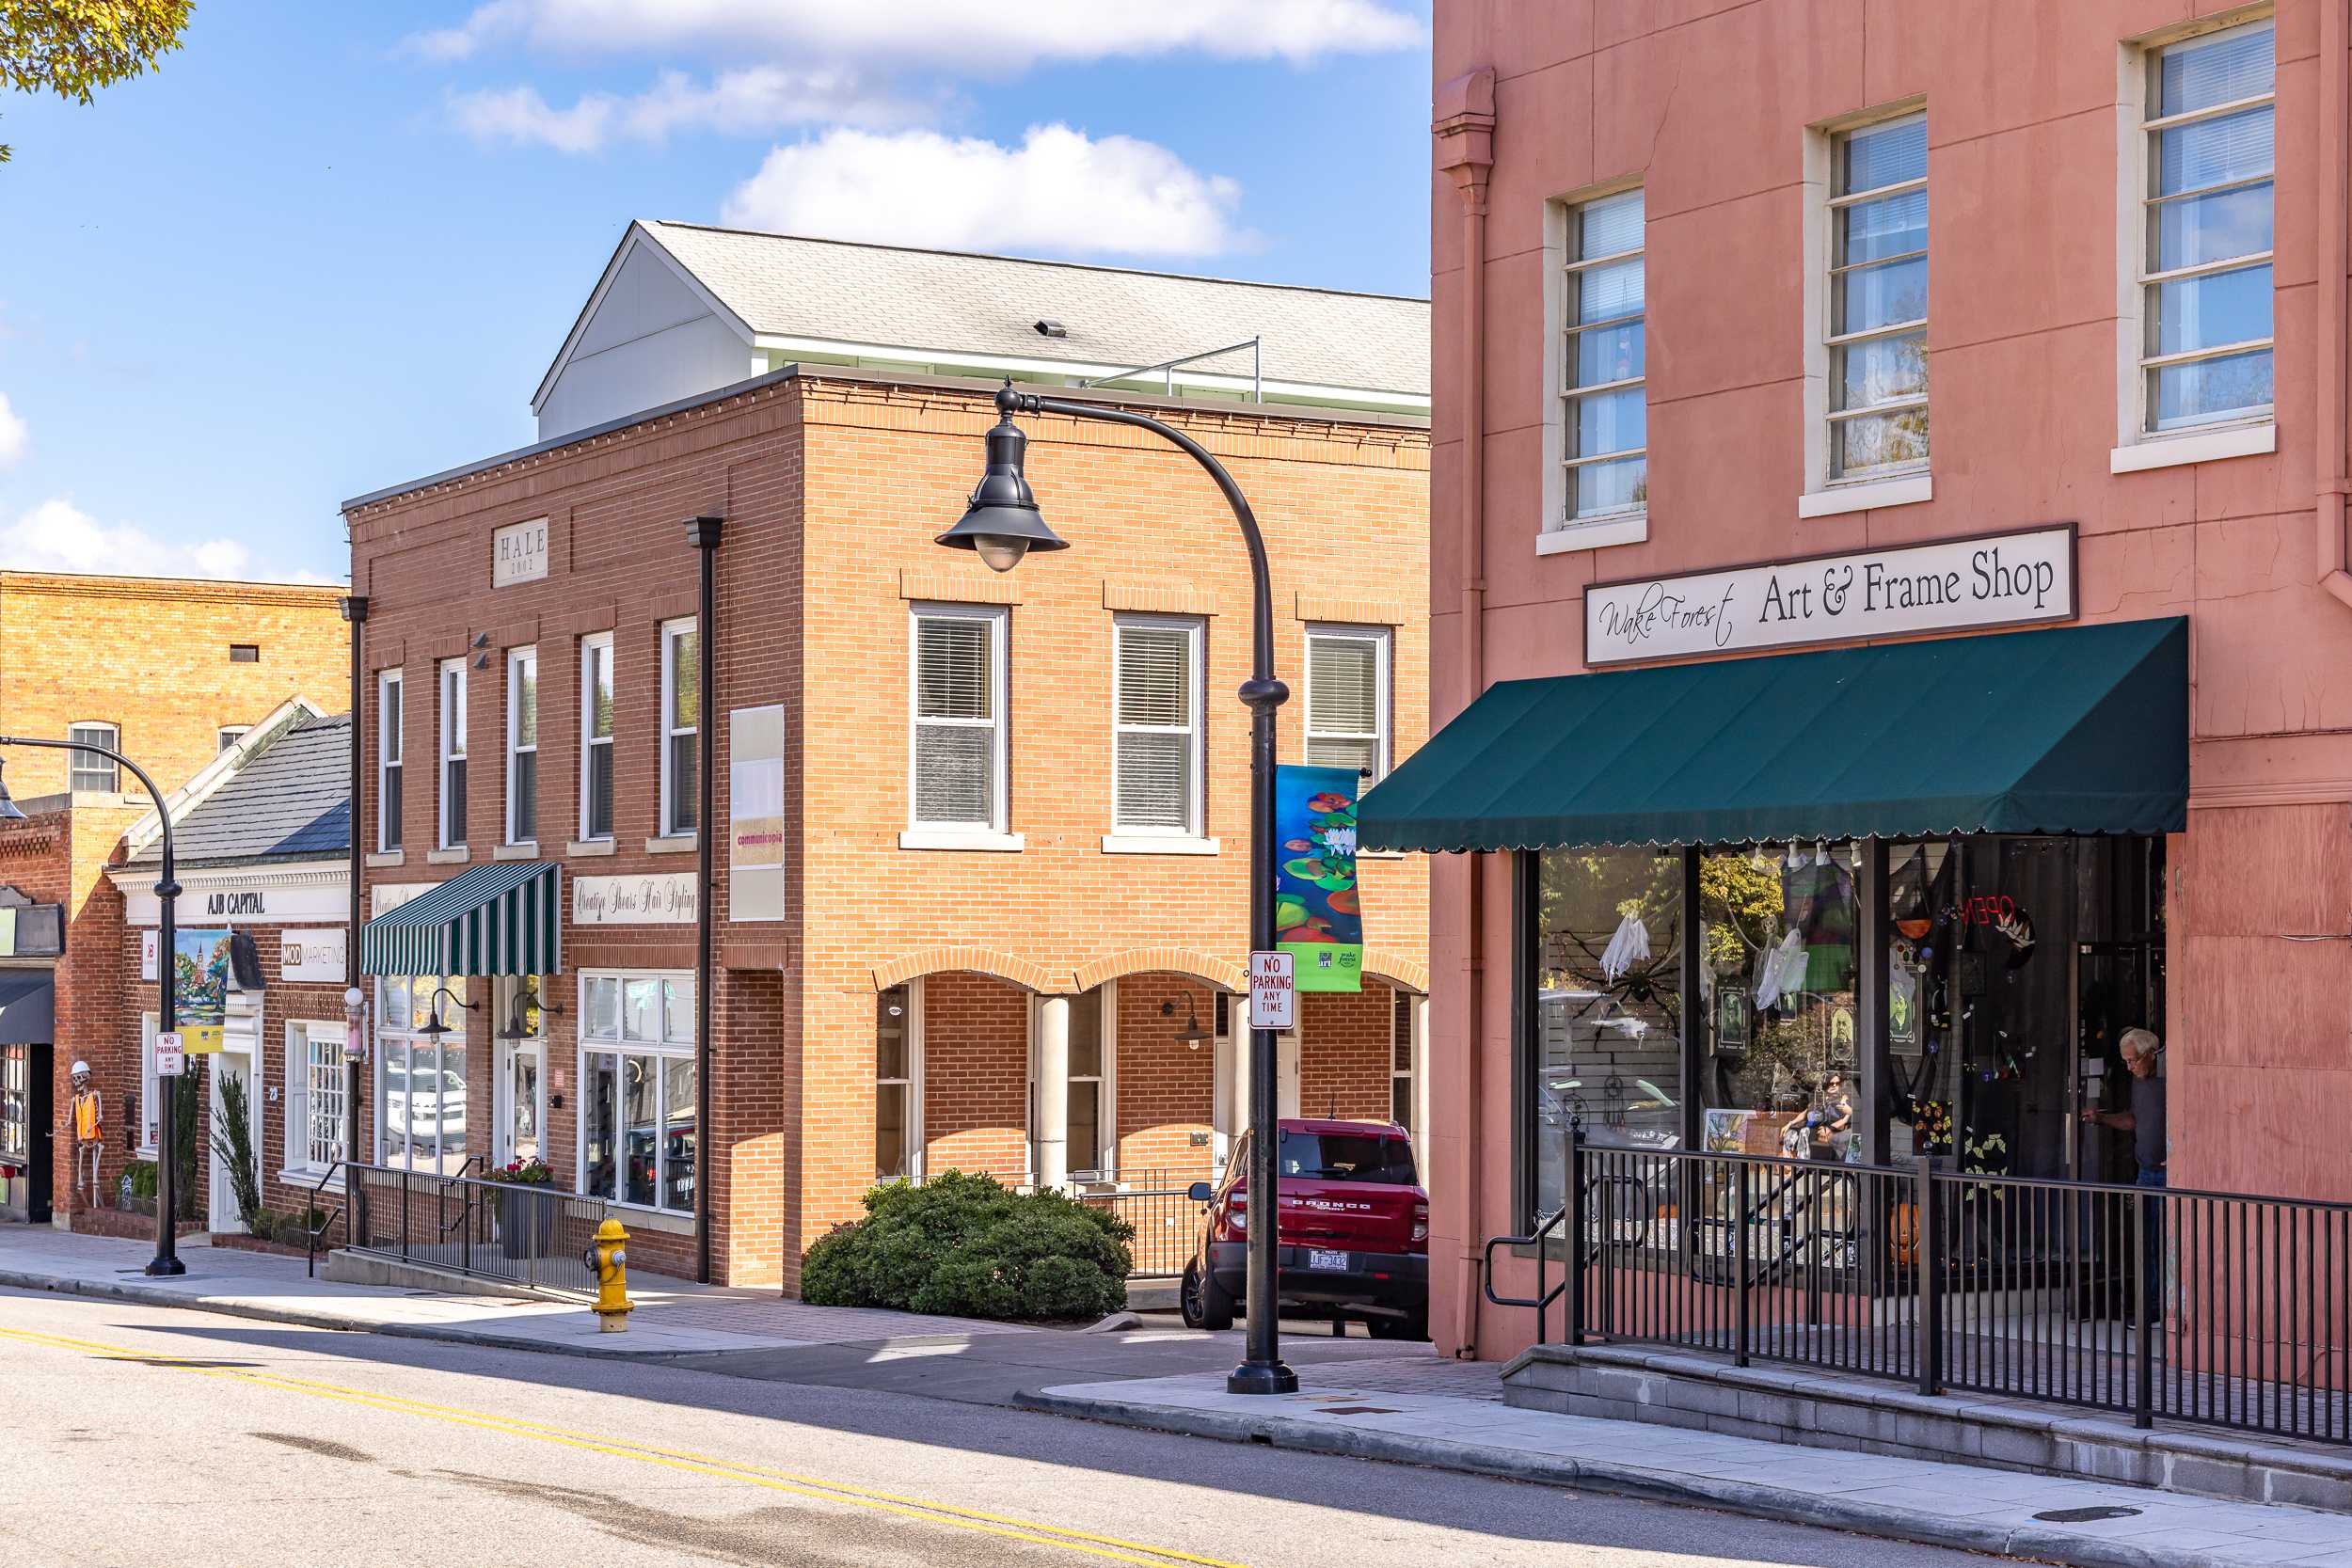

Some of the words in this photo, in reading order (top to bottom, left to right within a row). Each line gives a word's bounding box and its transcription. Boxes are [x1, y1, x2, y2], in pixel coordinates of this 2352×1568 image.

[501, 529, 545, 561] HALE
[1599, 582, 1663, 644] Wake
[1661, 582, 1734, 647] Forest
[1758, 575, 1813, 623] Art
[1823, 565, 1853, 616] &
[1864, 563, 1961, 611] Frame
[1972, 546, 2054, 610] Shop
[738, 831, 783, 846] communicopia
[207, 894, 224, 914] AJB
[227, 892, 265, 914] CAPITAL
[609, 879, 637, 914] Shears
[640, 879, 661, 912] Hair
[664, 877, 695, 919] Styling
[283, 945, 301, 964] MOD
[301, 946, 345, 964] MARKETING
[1263, 958, 1280, 973] NO
[1253, 975, 1291, 990] PARKING
[1263, 991, 1280, 1001] ANY
[1262, 1003, 1282, 1012] TIME
[164, 1037, 175, 1045] NO
[157, 1046, 182, 1054] PARKING
[1293, 1199, 1371, 1210] BRONCO
